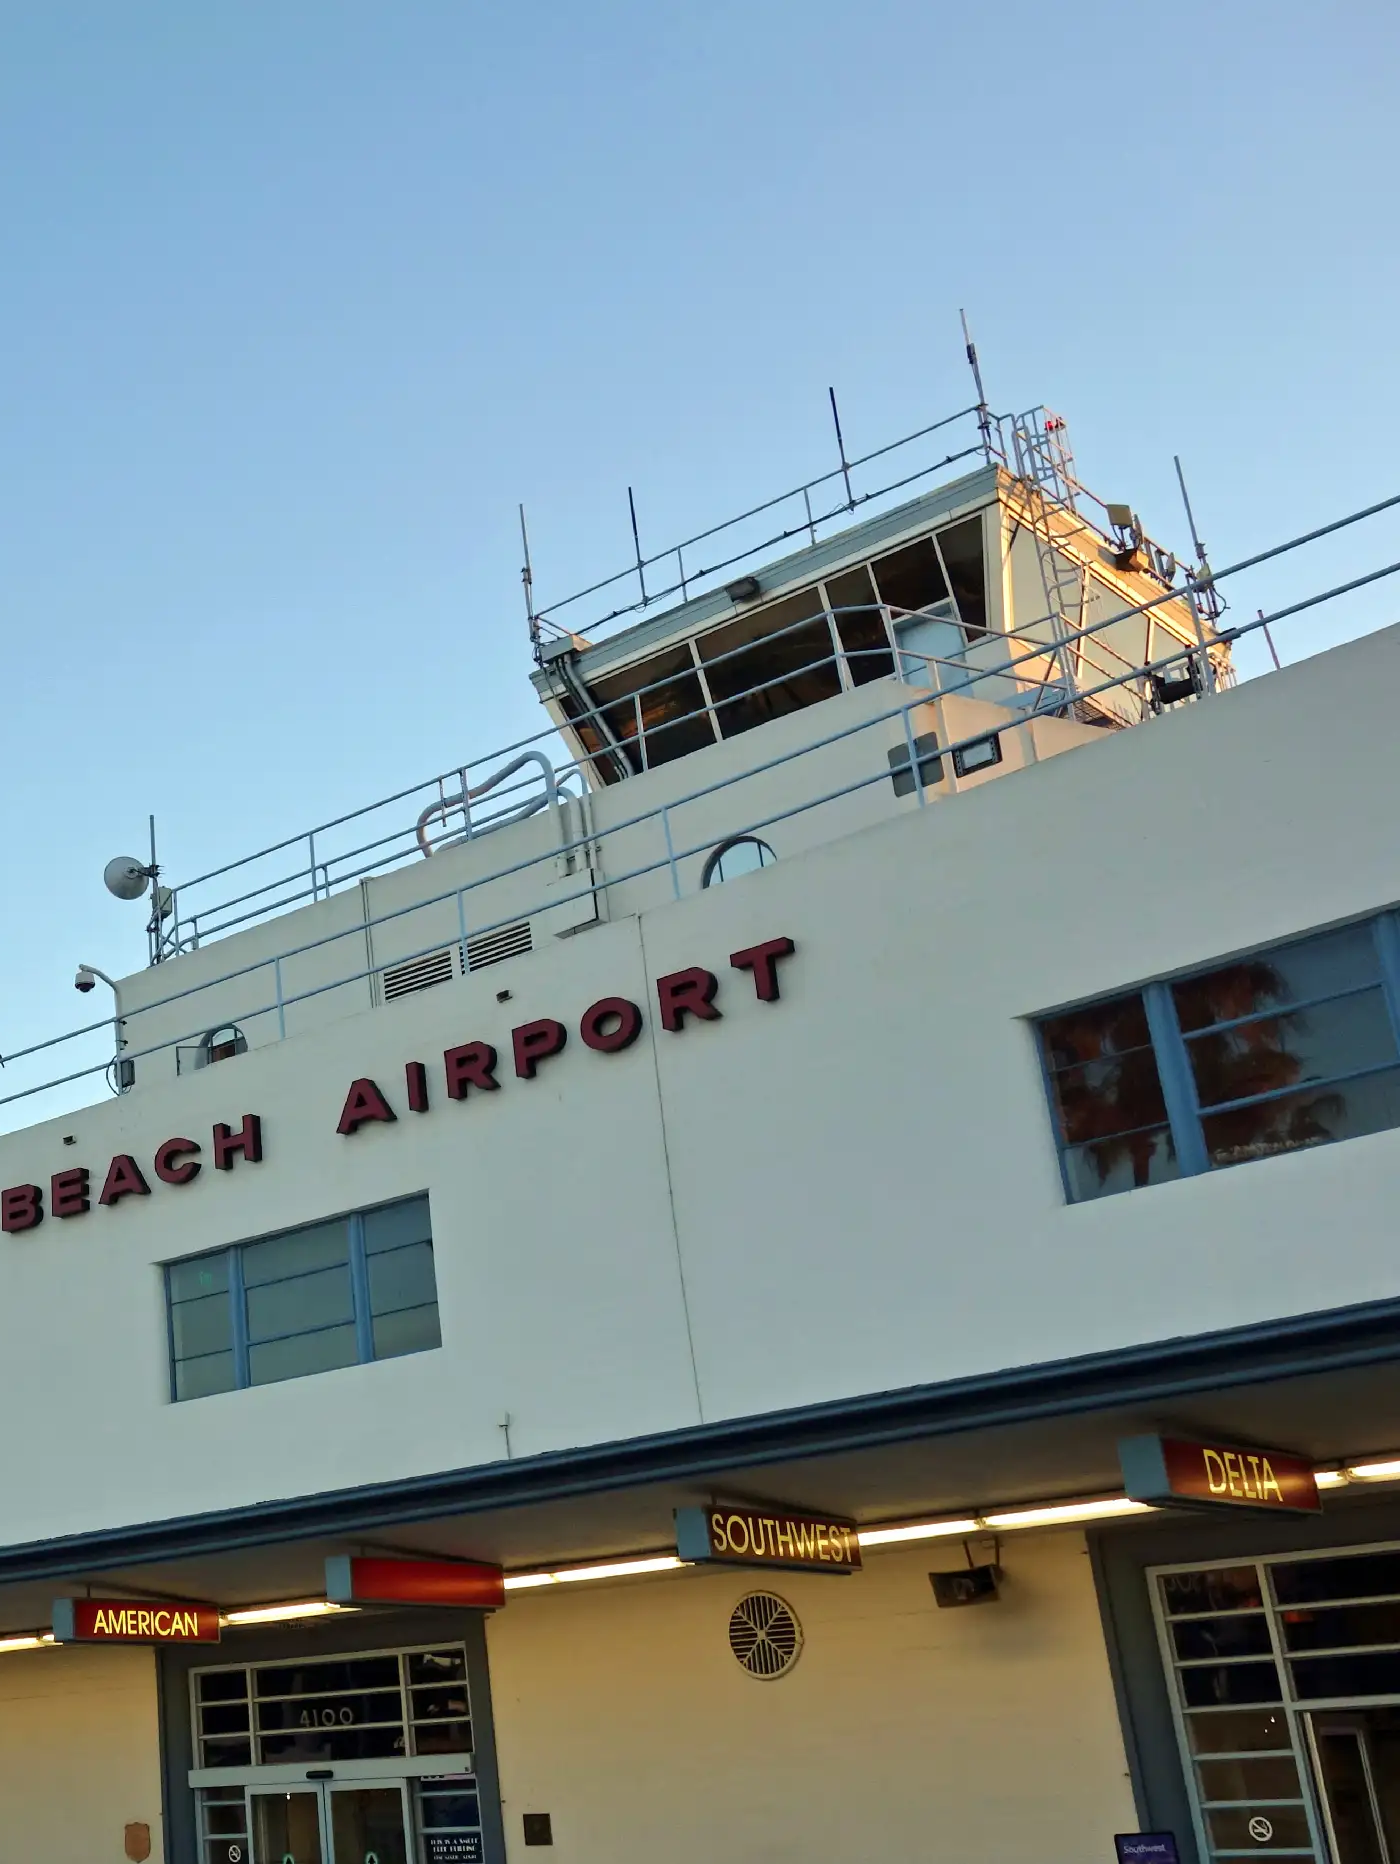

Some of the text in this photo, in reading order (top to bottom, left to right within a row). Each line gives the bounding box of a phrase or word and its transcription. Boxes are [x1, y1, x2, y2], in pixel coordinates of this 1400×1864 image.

[1, 1113, 263, 1233] BEACH
[336, 936, 796, 1136] AIRPORT
[1202, 1449, 1283, 1502] DELTA
[711, 1513, 852, 1563] SOUTHWEST
[93, 1609, 198, 1636] AMERICAN
[300, 1707, 354, 1728] 4100
